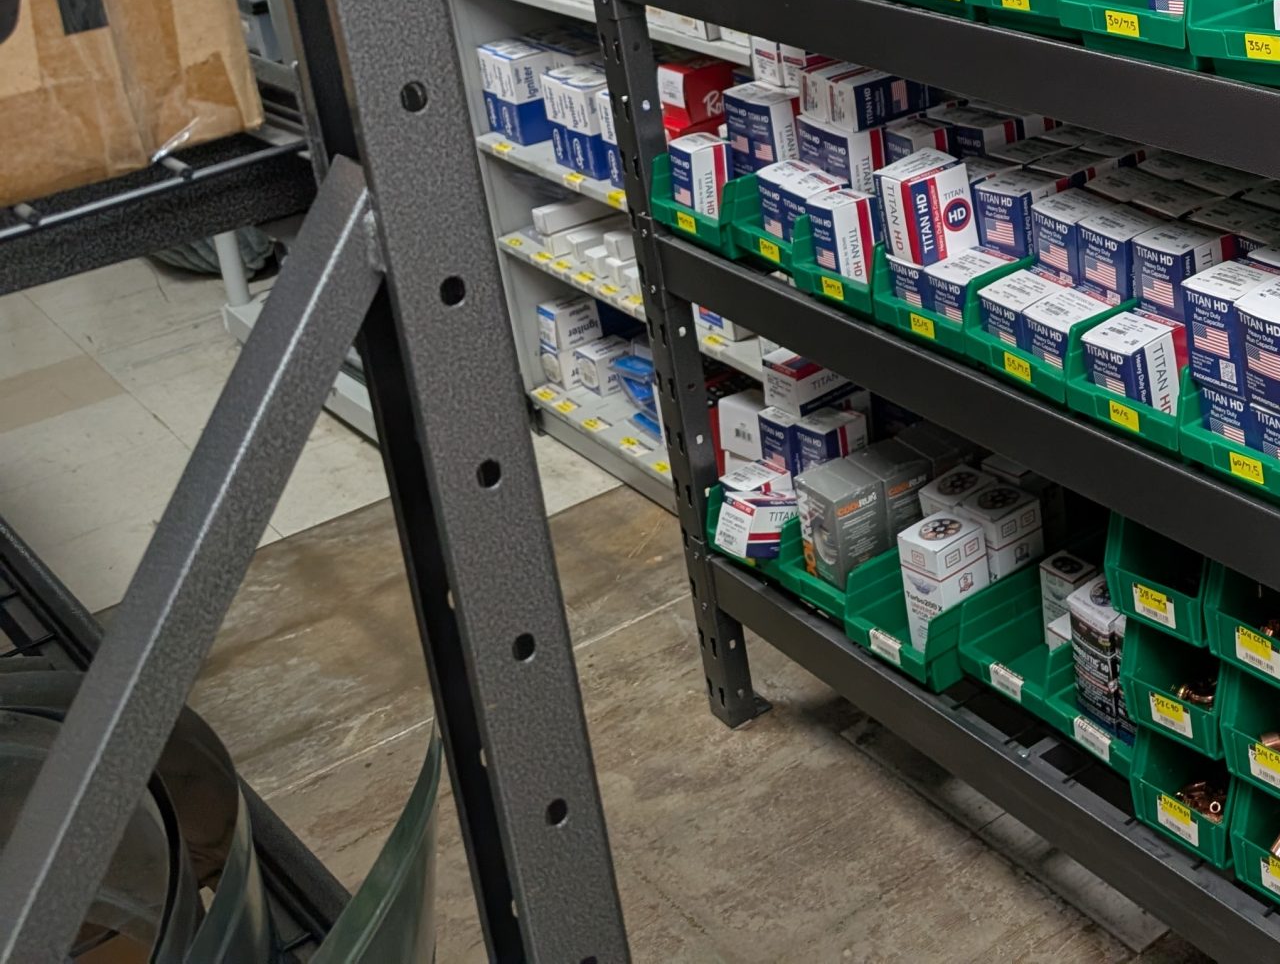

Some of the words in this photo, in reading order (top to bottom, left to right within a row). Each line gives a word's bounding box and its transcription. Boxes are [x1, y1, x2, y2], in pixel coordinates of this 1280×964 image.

[1107, 14, 1137, 32] 30/7.5
[1248, 38, 1272, 55] 35/5
[944, 187, 964, 201] TITAN
[916, 194, 928, 221] HD
[948, 207, 966, 222] HD
[922, 221, 934, 253] TITAN
[1080, 228, 1103, 246] TITAN
[1104, 237, 1117, 251] HD
[1186, 291, 1212, 311] TITAN
[1212, 299, 1228, 314] HD
[1232, 457, 1260, 478] 60/7.5
